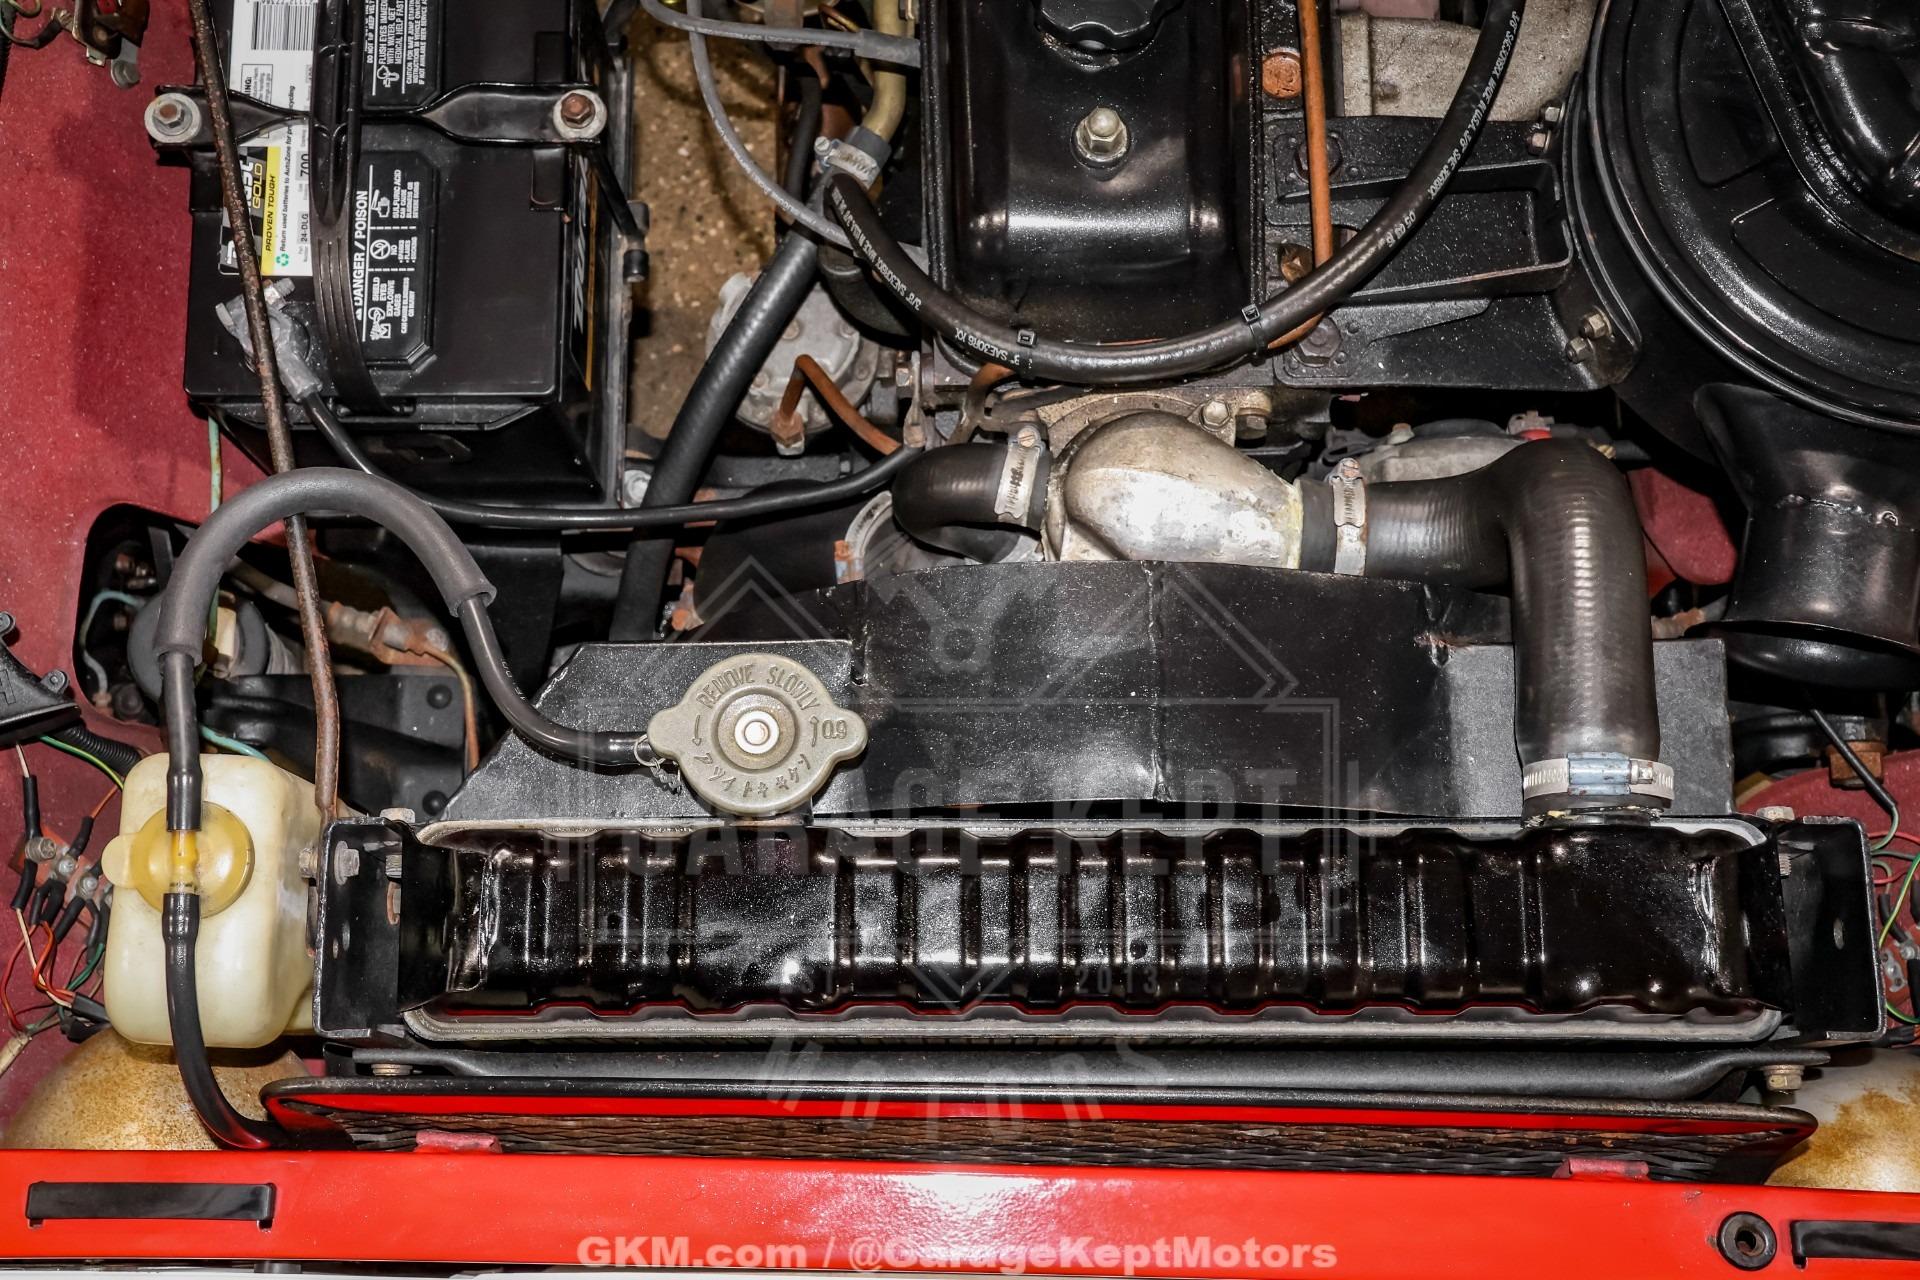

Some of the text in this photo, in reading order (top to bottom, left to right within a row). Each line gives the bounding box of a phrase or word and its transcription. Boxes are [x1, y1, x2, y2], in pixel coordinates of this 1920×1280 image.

[388, 7, 396, 21] GET
[395, 18, 403, 35] HELP
[379, 26, 387, 42] EYES
[378, 44, 387, 65] FLUSH
[387, 48, 395, 64] WITH
[395, 36, 403, 64] MEDICAL
[1482, 76, 1497, 105] MADE
[284, 146, 292, 176] AutoZone
[252, 163, 263, 209] GOLD
[393, 169, 402, 186] ACID
[265, 174, 276, 252] PROVEN TOUGH
[354, 190, 368, 239] POISON
[390, 244, 397, 256] NO
[353, 252, 365, 306] DANGER
[386, 280, 395, 317] EXPLOSIVE
[696, 663, 820, 711] REMOVE SLOWLY
[822, 719, 848, 740] 0.9
